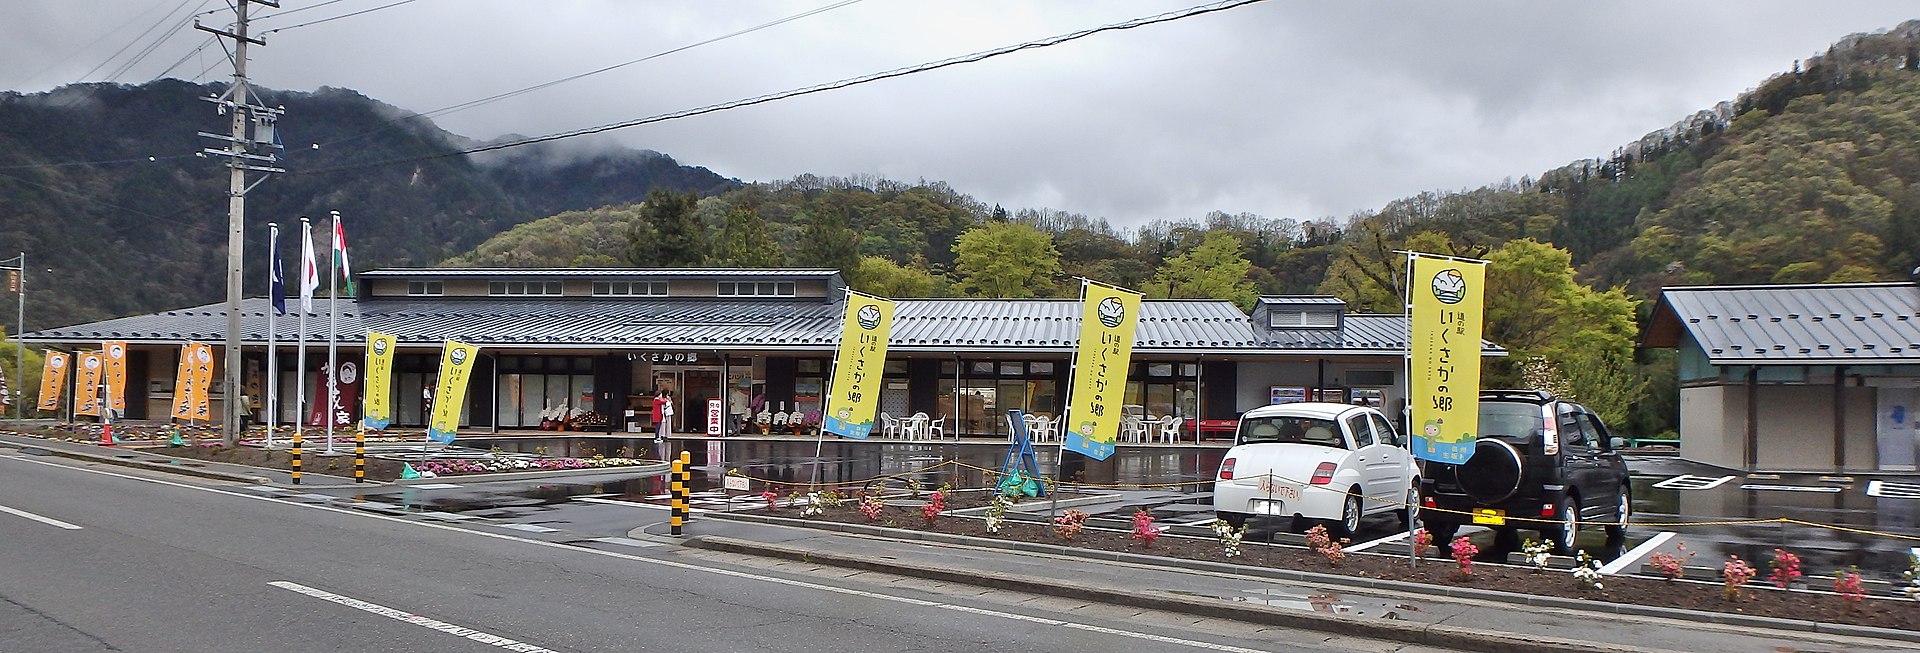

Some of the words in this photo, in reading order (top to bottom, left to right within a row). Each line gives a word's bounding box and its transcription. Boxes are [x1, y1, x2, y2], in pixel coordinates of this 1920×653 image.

[1456, 311, 1465, 336] 道の駅
[627, 352, 698, 362] いくさかの郷
[847, 332, 870, 404] いくさかの郷
[1090, 331, 1113, 417] いくさかの郷
[1432, 309, 1455, 412] いくさかの郷
[709, 409, 720, 433] 営業中
